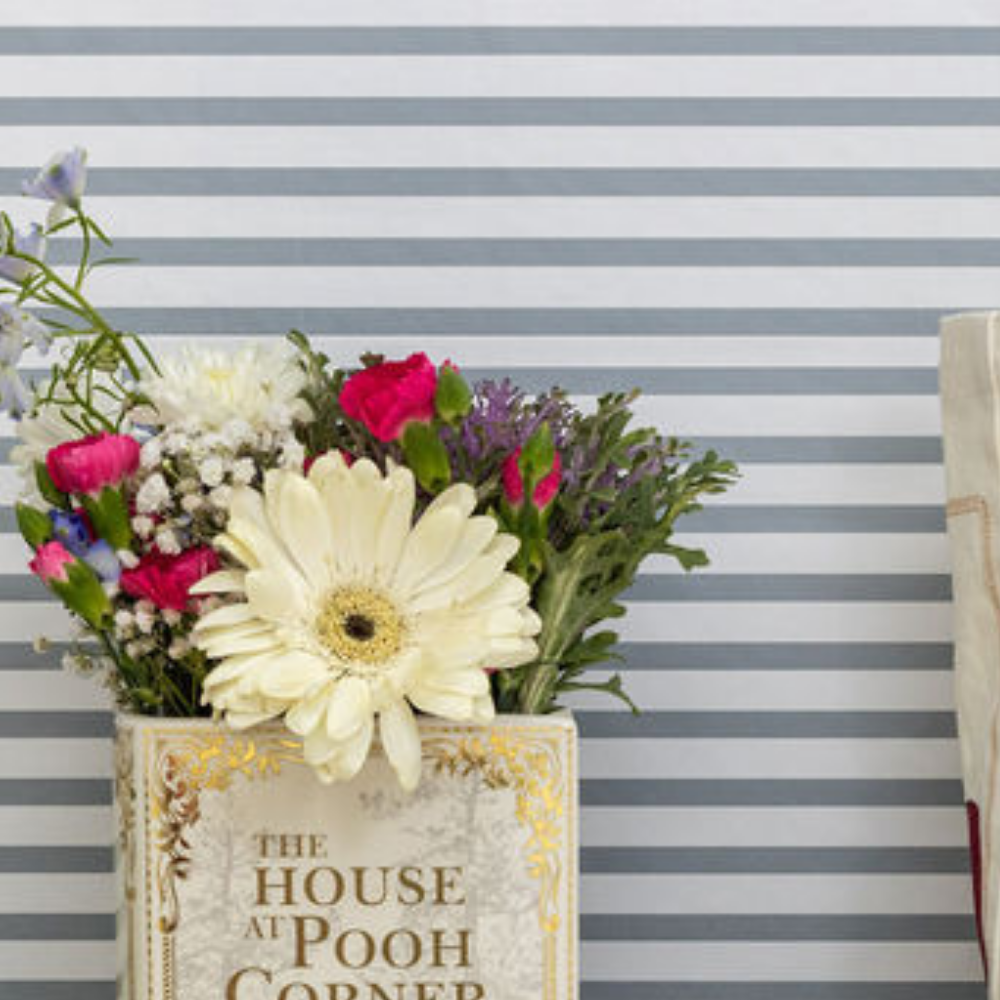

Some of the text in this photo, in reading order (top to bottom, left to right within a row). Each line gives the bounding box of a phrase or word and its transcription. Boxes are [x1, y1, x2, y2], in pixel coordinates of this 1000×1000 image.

[254, 834, 328, 858] THE
[254, 866, 466, 906] HOUSE
[244, 915, 471, 969] AT POOH
